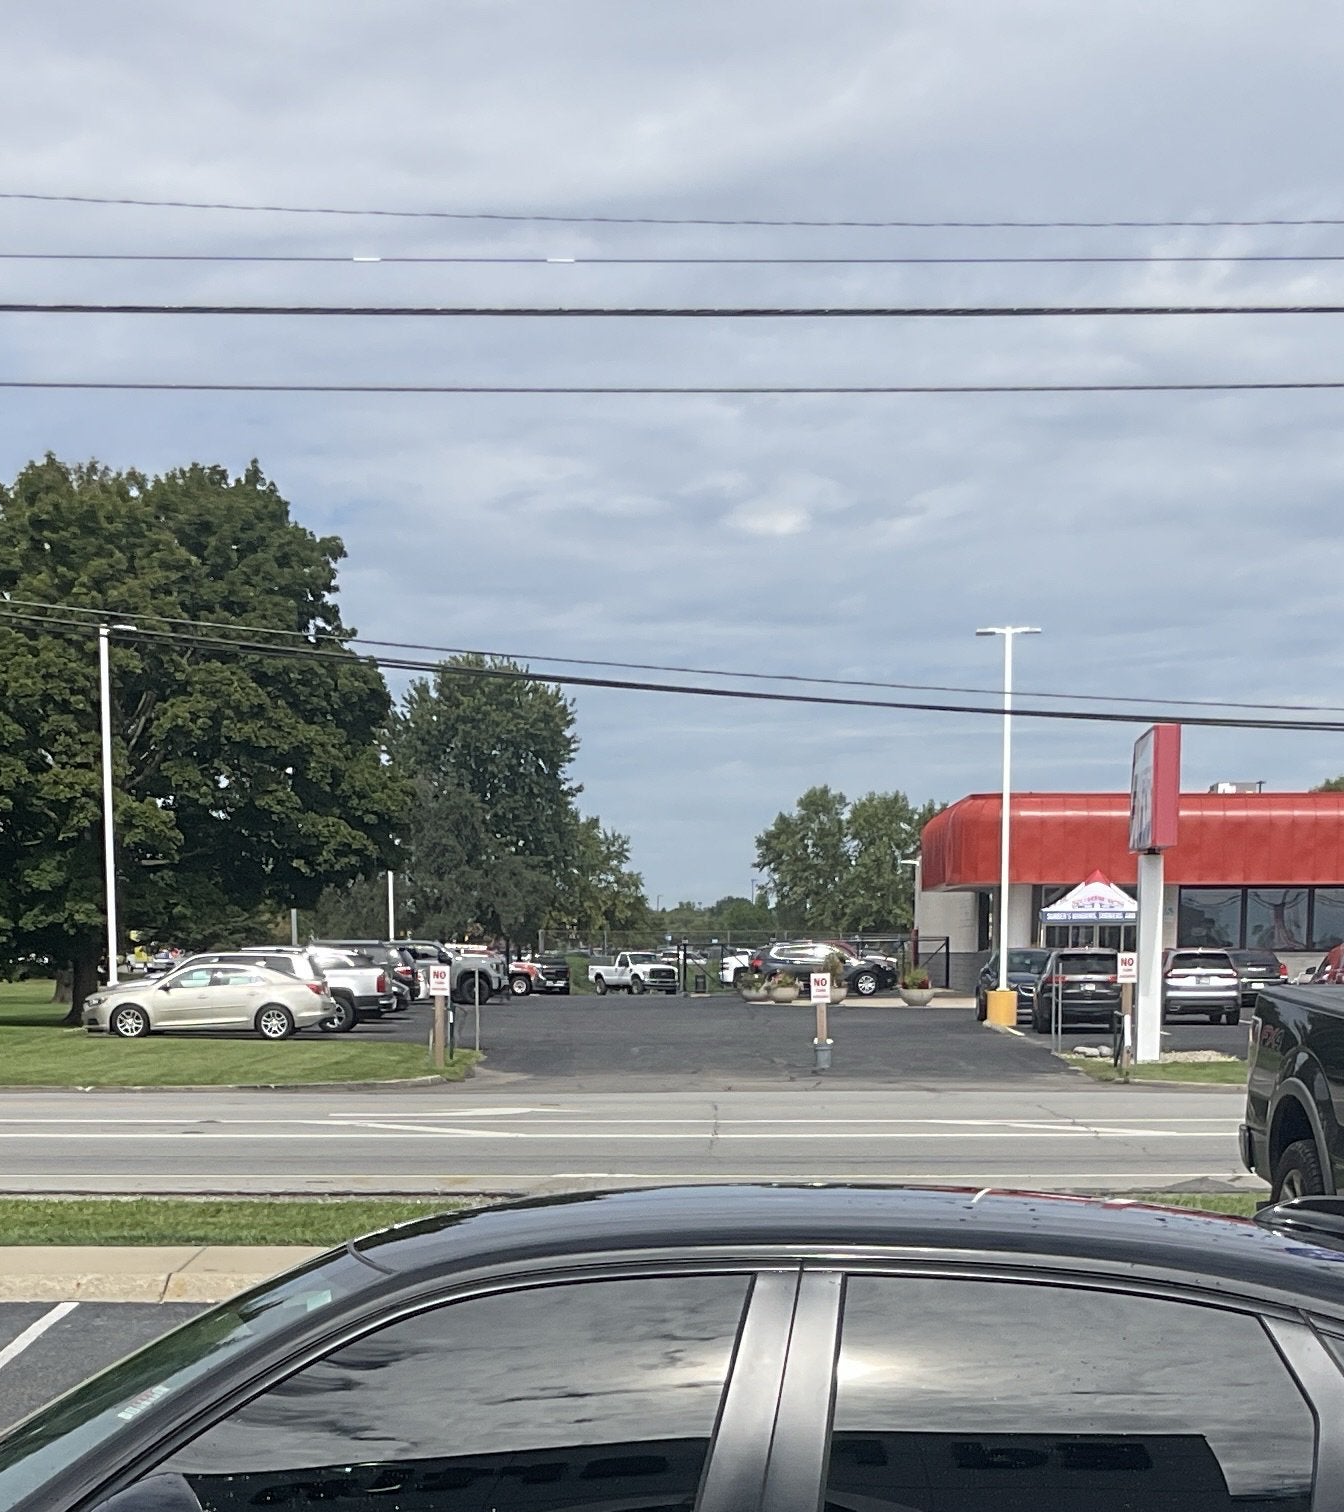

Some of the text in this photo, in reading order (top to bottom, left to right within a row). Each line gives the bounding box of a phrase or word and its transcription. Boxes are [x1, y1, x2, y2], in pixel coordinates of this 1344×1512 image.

[1120, 958, 1134, 966] NO
[433, 971, 446, 979] NO
[814, 978, 827, 986] NO
